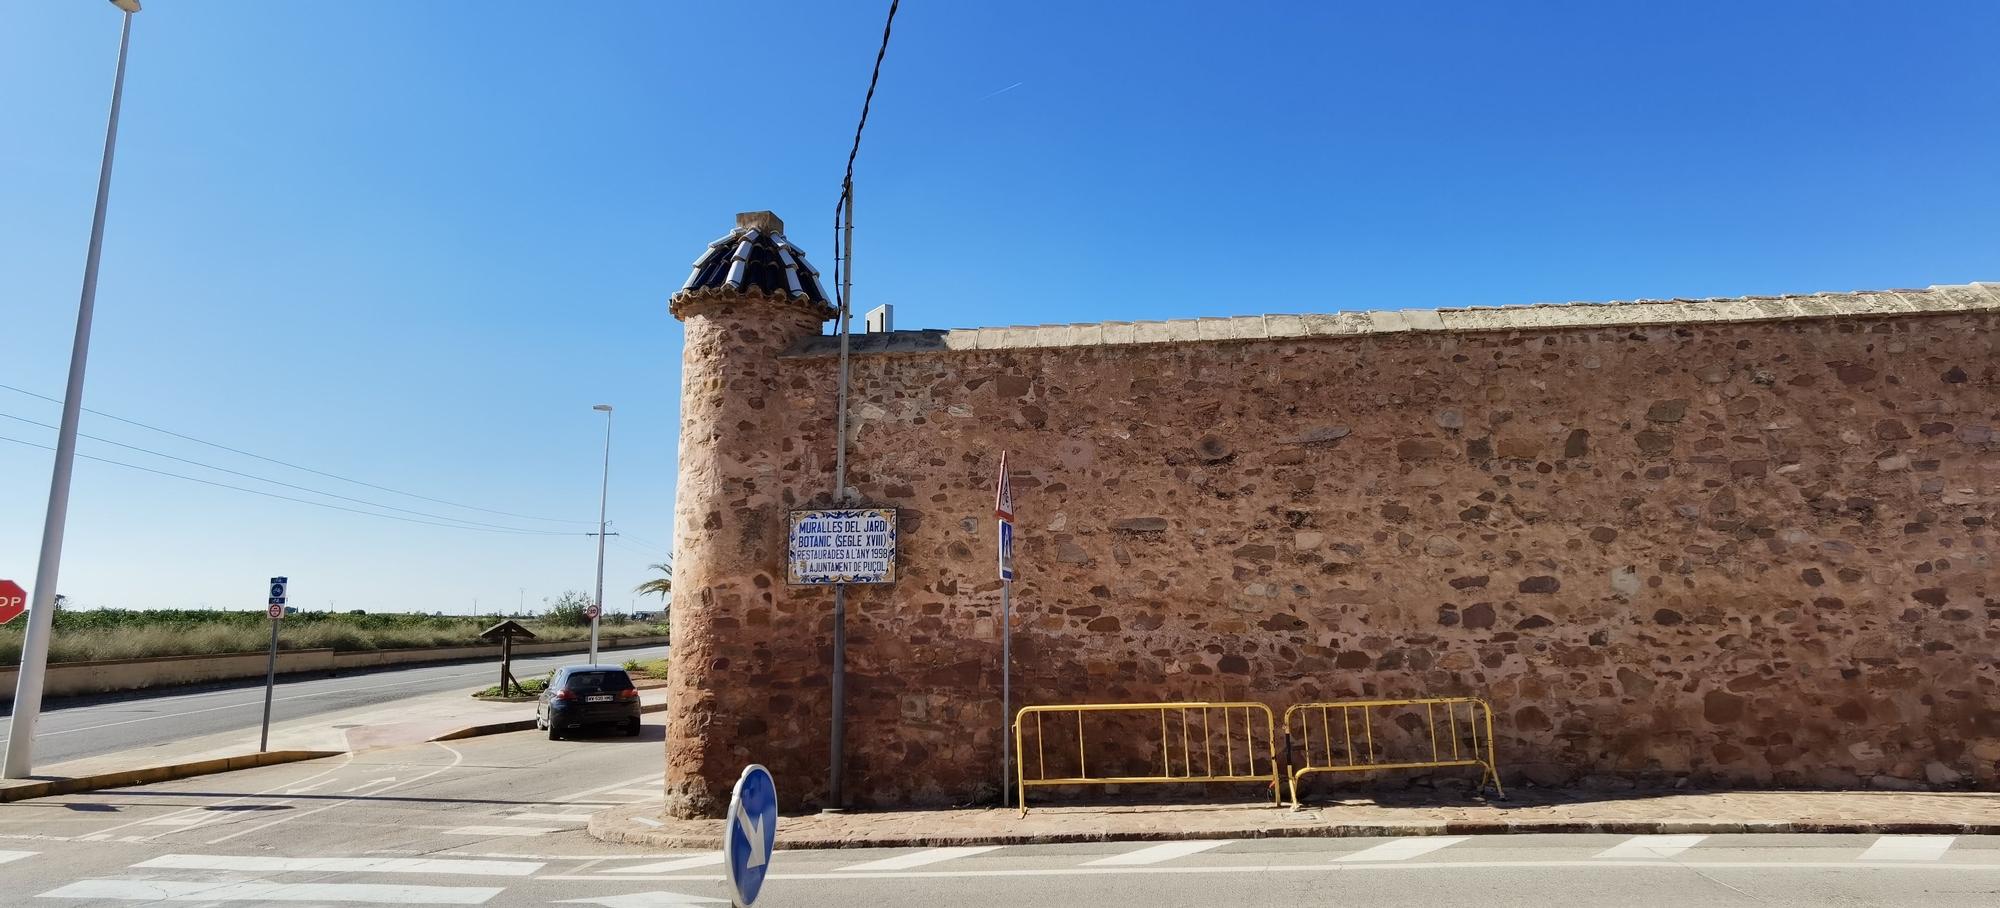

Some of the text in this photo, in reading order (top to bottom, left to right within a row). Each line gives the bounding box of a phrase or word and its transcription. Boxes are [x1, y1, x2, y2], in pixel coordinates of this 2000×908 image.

[799, 521, 842, 533] MURALLES
[845, 521, 860, 532] DEL
[835, 534, 862, 548] (SEGLE
[866, 534, 886, 546] XVIII)
[796, 549, 844, 560] RESTAURADES
[846, 550, 850, 559] A
[852, 548, 870, 559] L'ANY
[810, 562, 886, 573] AJUNTAMENT DE PUÇOL
[0, 596, 22, 606] OP
